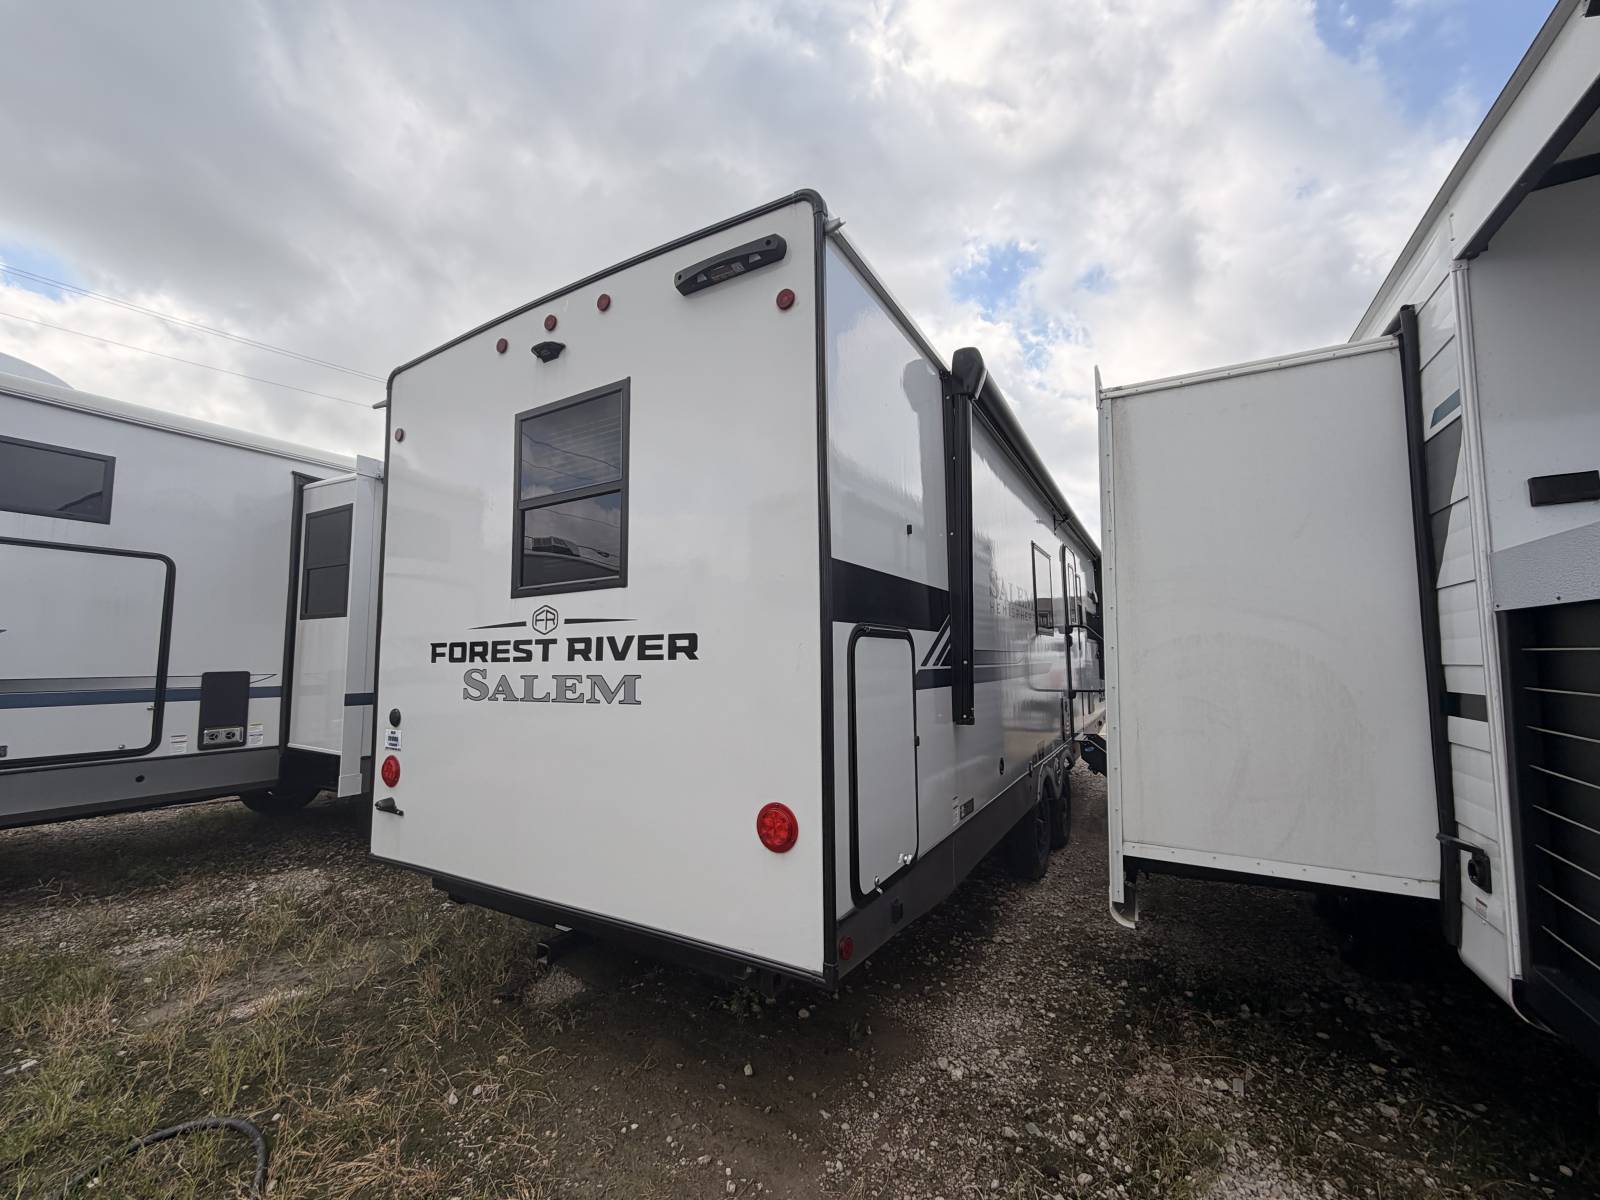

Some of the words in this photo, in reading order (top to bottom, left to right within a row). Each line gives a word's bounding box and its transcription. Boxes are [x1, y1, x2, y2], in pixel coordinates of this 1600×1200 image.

[430, 638, 557, 663] FOREST
[566, 633, 699, 662] RIVER
[462, 668, 642, 705] SALEM
